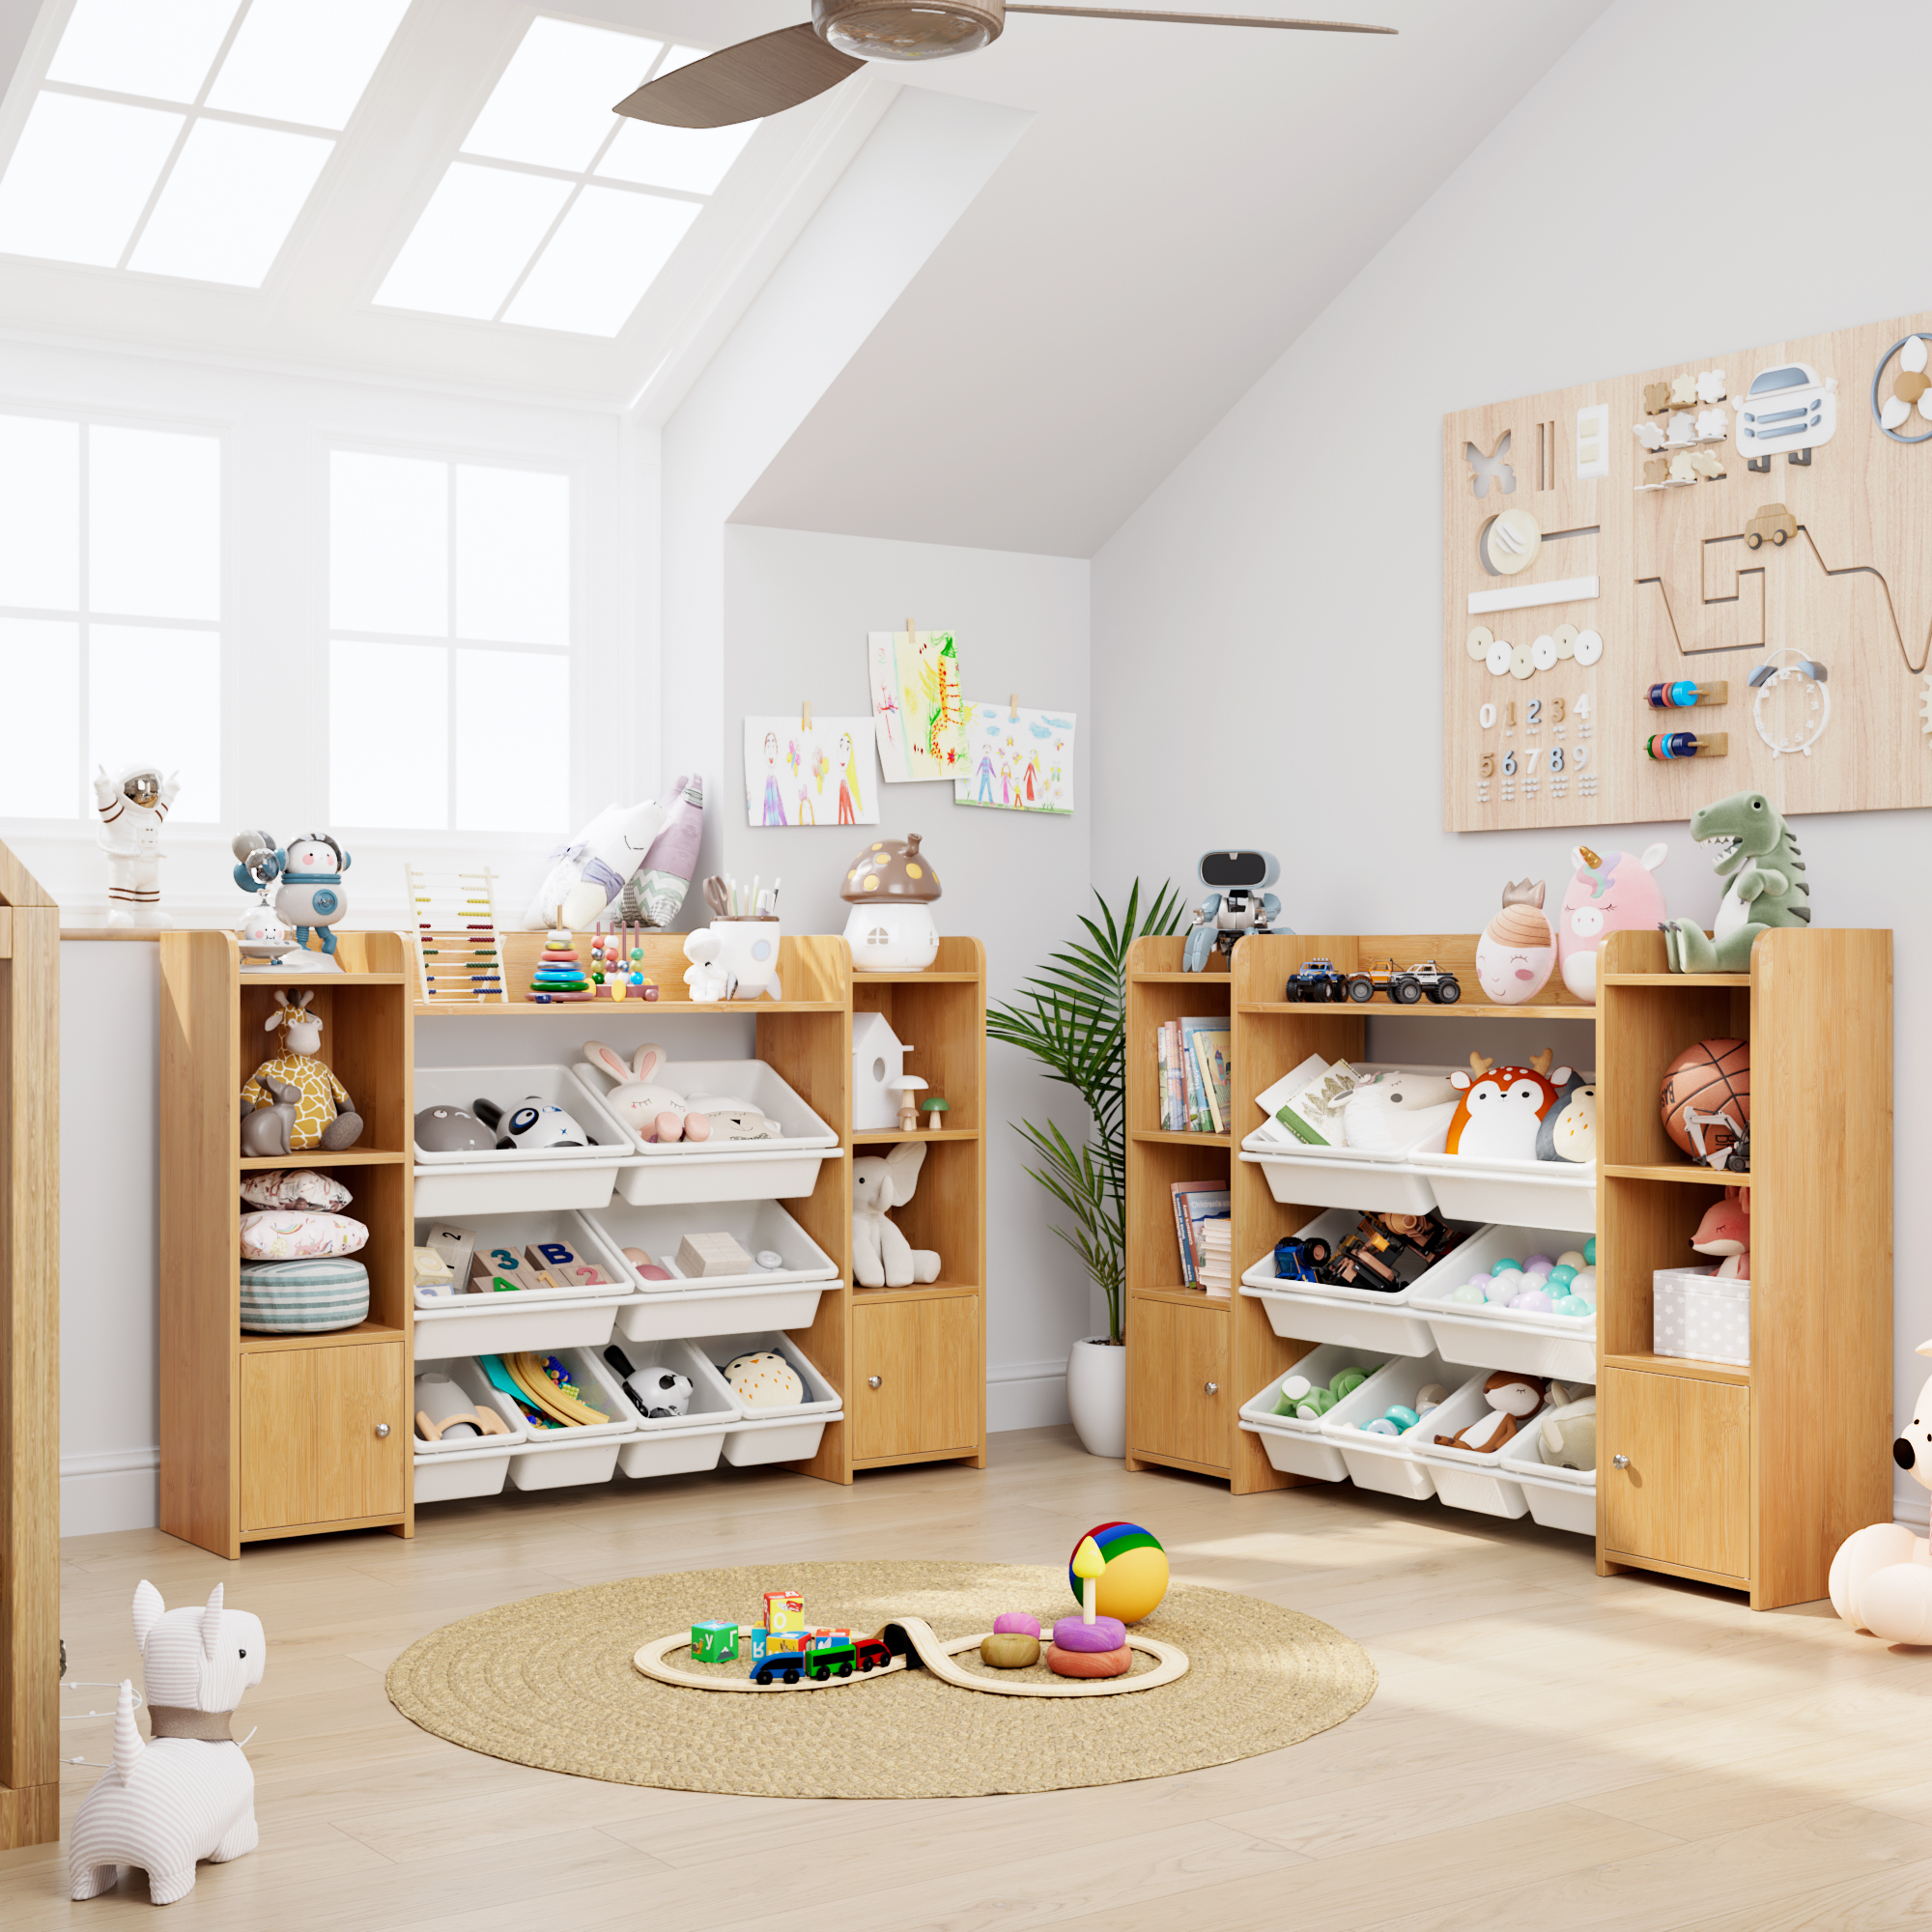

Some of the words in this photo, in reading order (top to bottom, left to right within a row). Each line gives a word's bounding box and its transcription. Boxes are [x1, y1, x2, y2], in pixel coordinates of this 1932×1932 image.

[1806, 684, 1815, 693] 2
[1479, 703, 1496, 728] 0
[1506, 701, 1516, 725] 1
[1526, 699, 1542, 724] 2
[1550, 697, 1566, 723] 3
[1573, 694, 1591, 719] 4
[1810, 701, 1819, 710] 3
[1479, 753, 1495, 778] 5
[1502, 751, 1518, 776] 6
[1524, 749, 1542, 774] 7
[1549, 747, 1565, 772] 8
[1573, 745, 1590, 771] 9
[1190, 1047, 1200, 1090] Happiness
[1191, 1200, 1222, 1209] Children's
[441, 1232, 462, 1241] 2
[491, 1250, 519, 1270] 3
[537, 1243, 574, 1264] B
[537, 1270, 559, 1288] 1
[577, 1267, 607, 1286] 2
